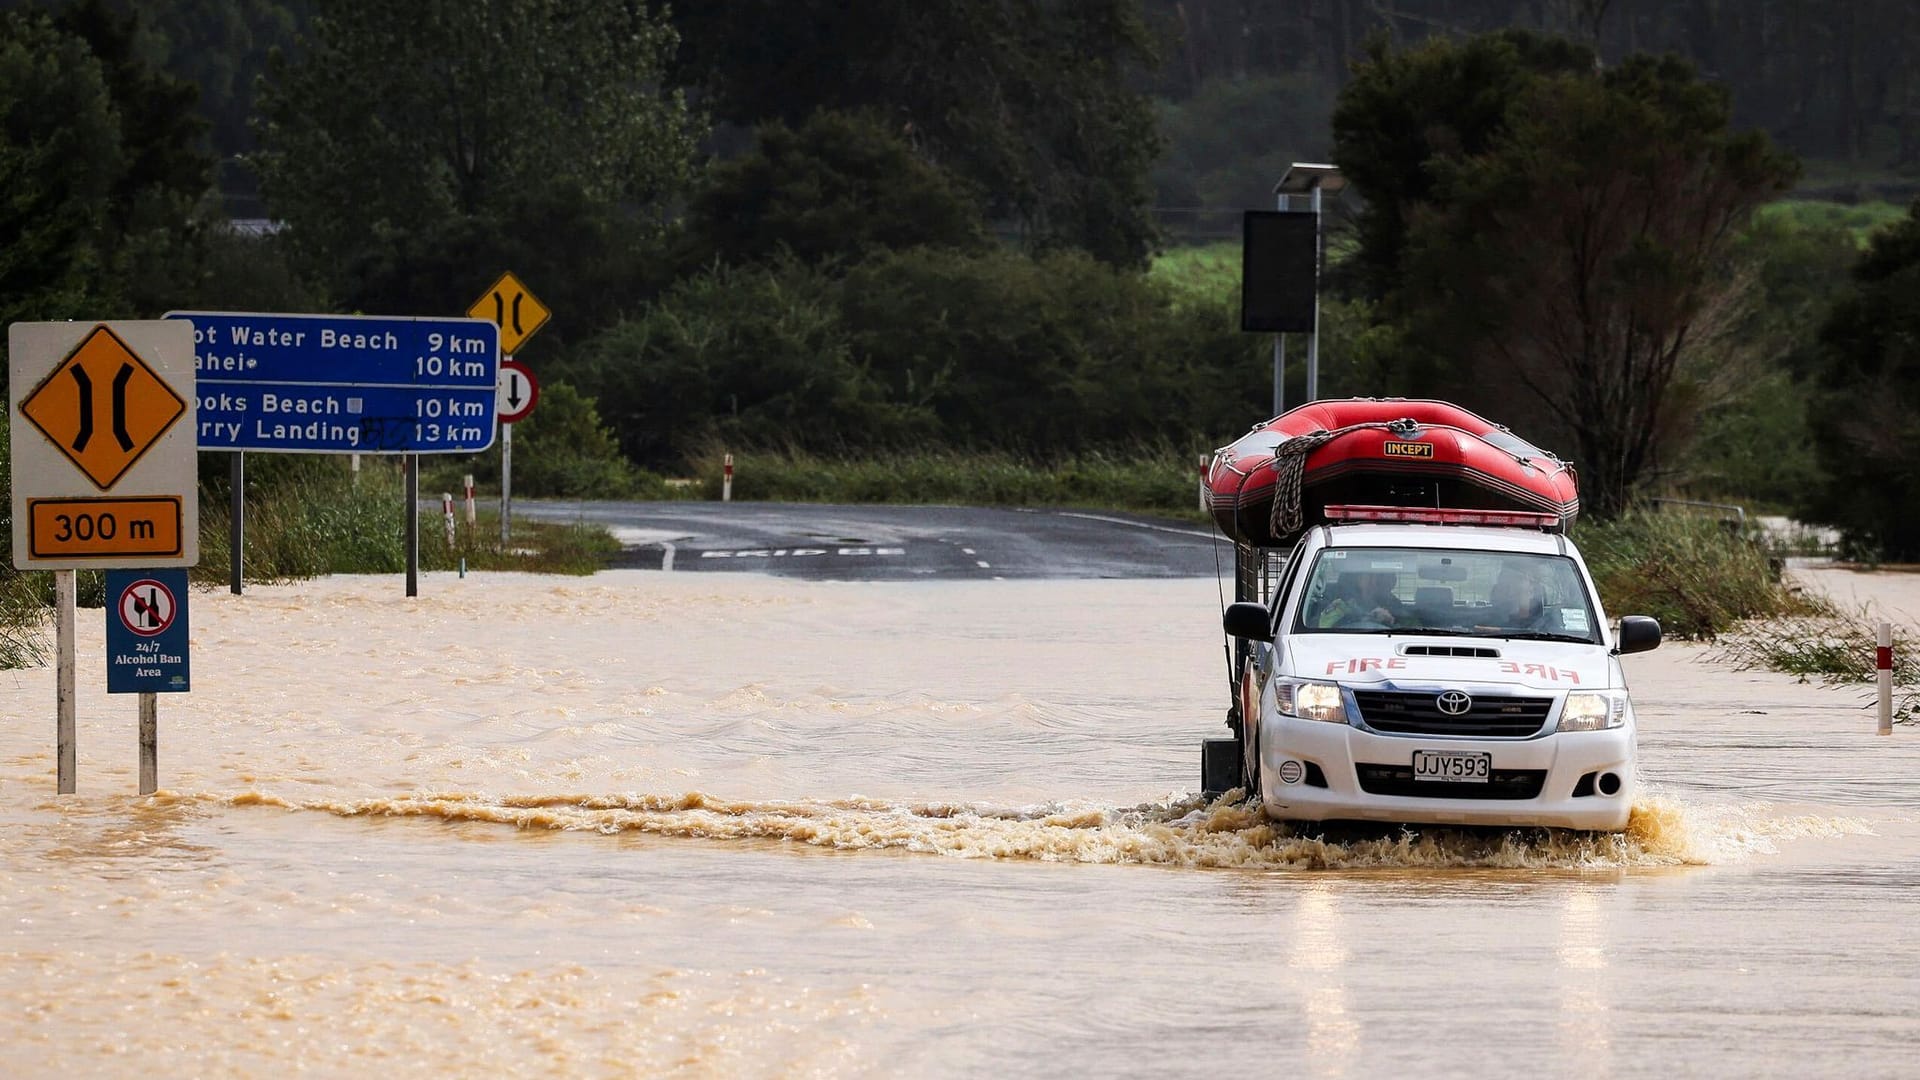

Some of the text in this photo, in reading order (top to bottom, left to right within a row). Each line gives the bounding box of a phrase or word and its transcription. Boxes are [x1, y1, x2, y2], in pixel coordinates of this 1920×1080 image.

[194, 326, 485, 353] ot Water Beach 9 km
[194, 352, 485, 376] ahei 10 km
[195, 393, 484, 417] oks Beach 10 km
[198, 421, 241, 442] rry
[256, 420, 360, 446] Landing
[415, 423, 440, 442] 13
[447, 424, 481, 441] km
[1387, 443, 1431, 455] INCEPT
[54, 513, 155, 542] 300 m
[136, 640, 160, 653] 24/7
[115, 653, 182, 665] Alcohol Ban
[1326, 657, 1408, 675] FIRE
[135, 667, 162, 677] Area
[1416, 756, 1488, 777] JJY593
